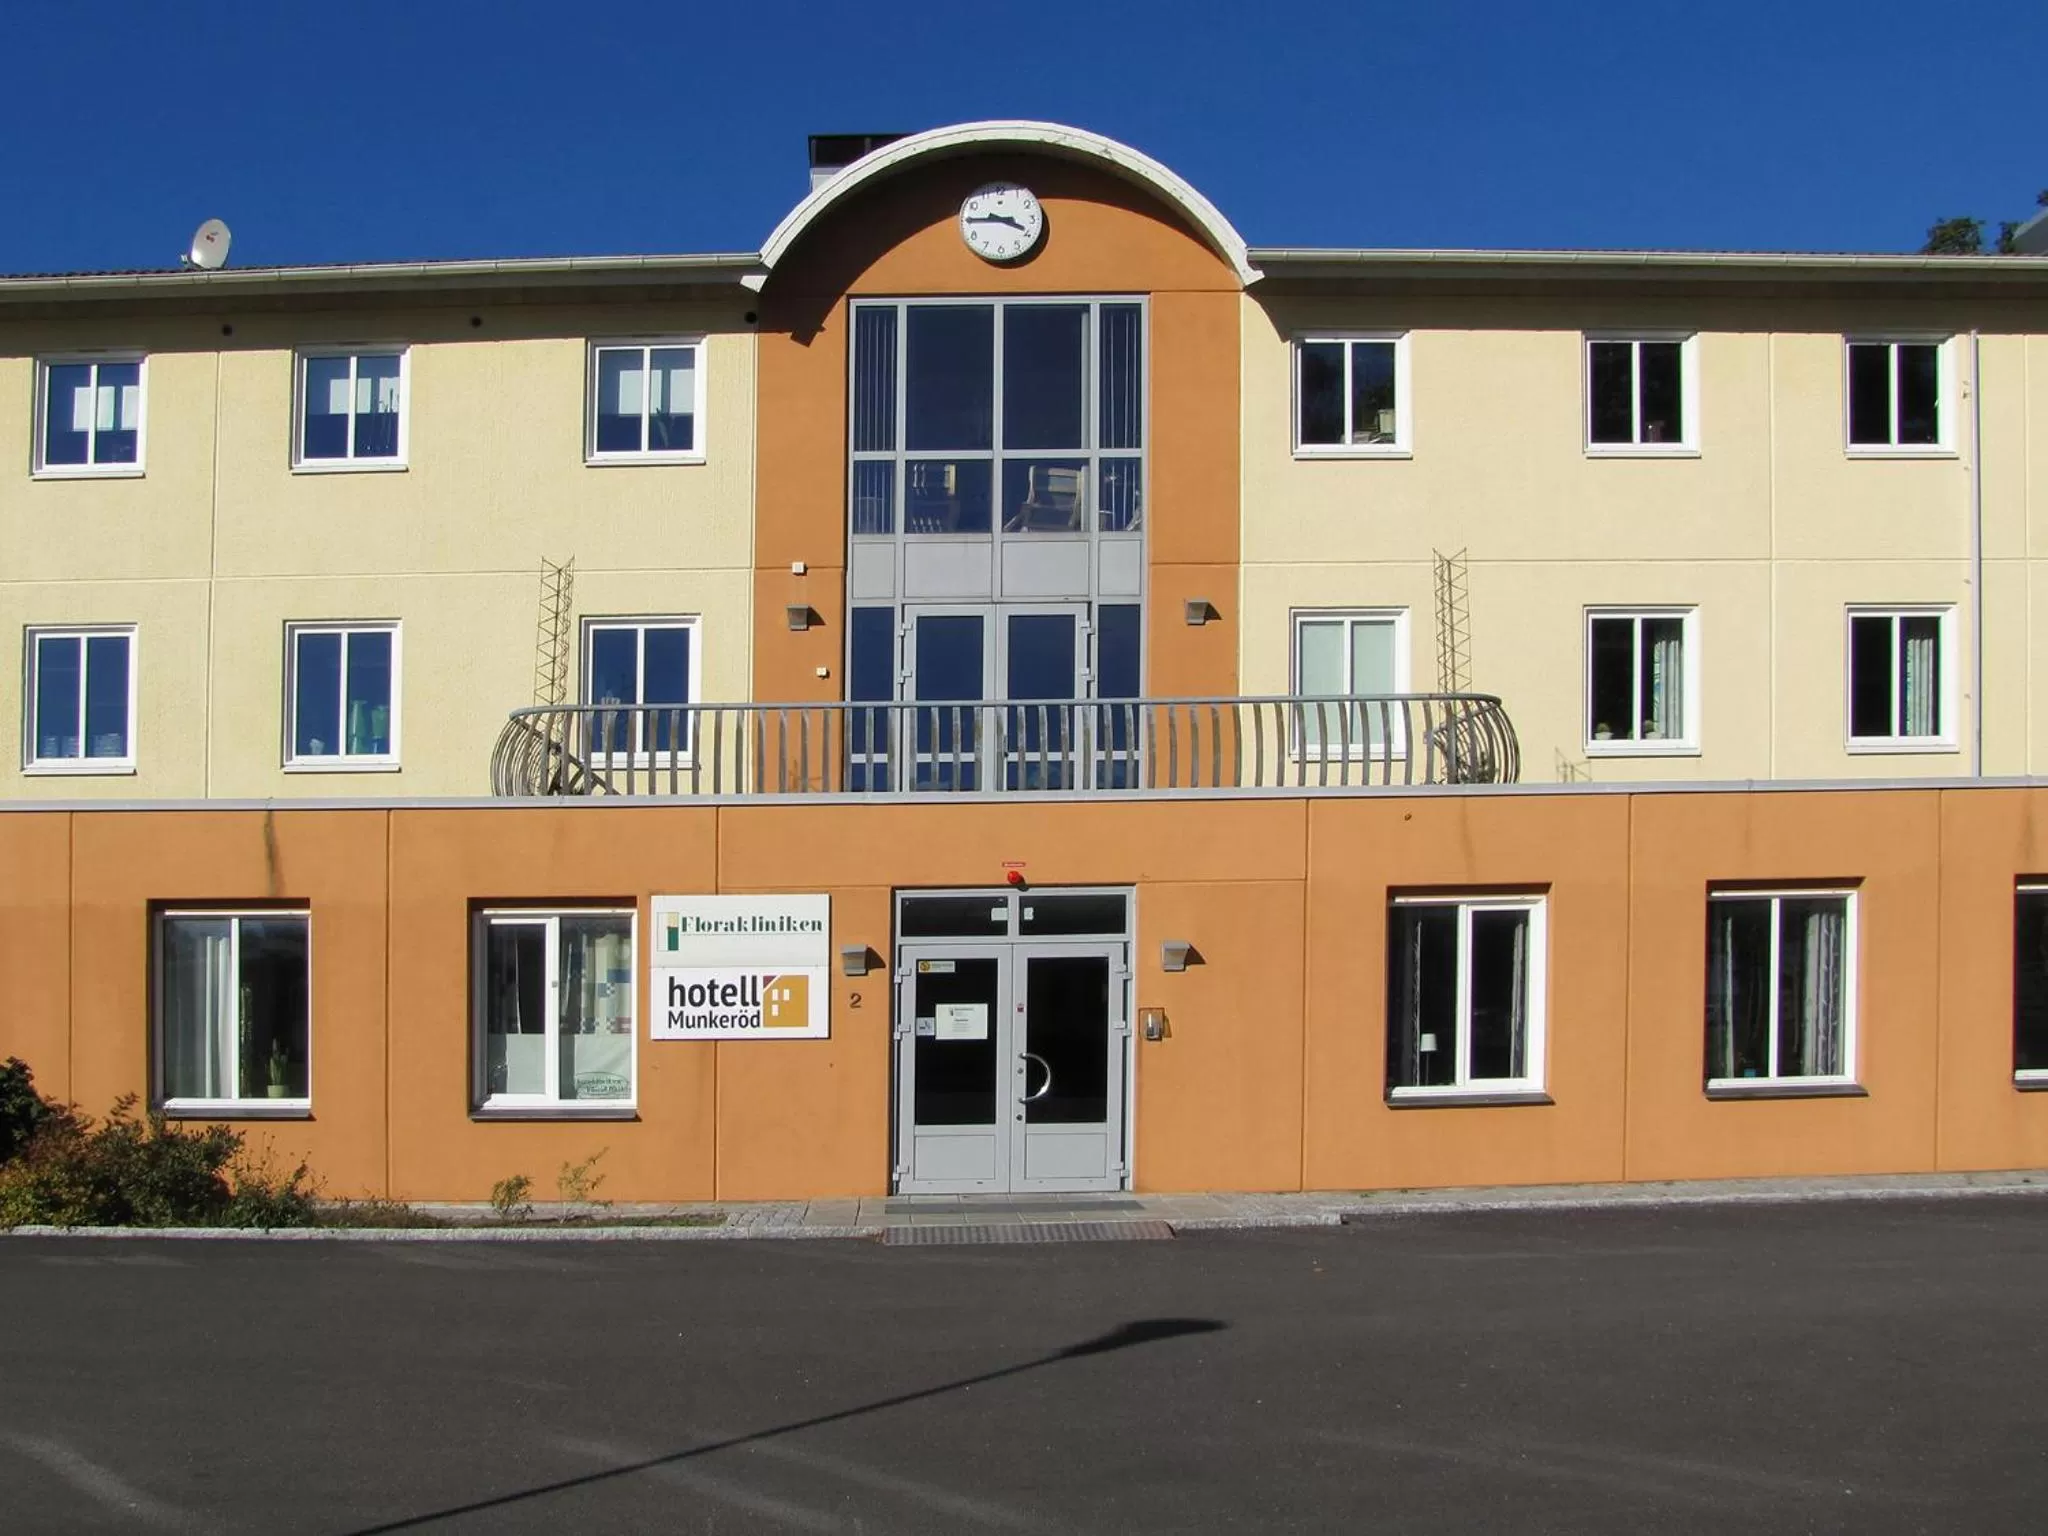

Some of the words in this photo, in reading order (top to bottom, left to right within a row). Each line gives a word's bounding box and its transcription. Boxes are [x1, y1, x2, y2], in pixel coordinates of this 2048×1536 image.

[996, 186, 1005, 195] 12
[1023, 200, 1031, 209] 2
[1029, 215, 1036, 224] 3
[970, 230, 977, 240] 8
[998, 245, 1005, 253] 6
[1014, 241, 1020, 250] 5
[682, 916, 823, 932] Florakliniken
[668, 975, 760, 1007] hotell
[849, 993, 862, 1008] 2
[668, 1009, 760, 1029] Munkeröd
